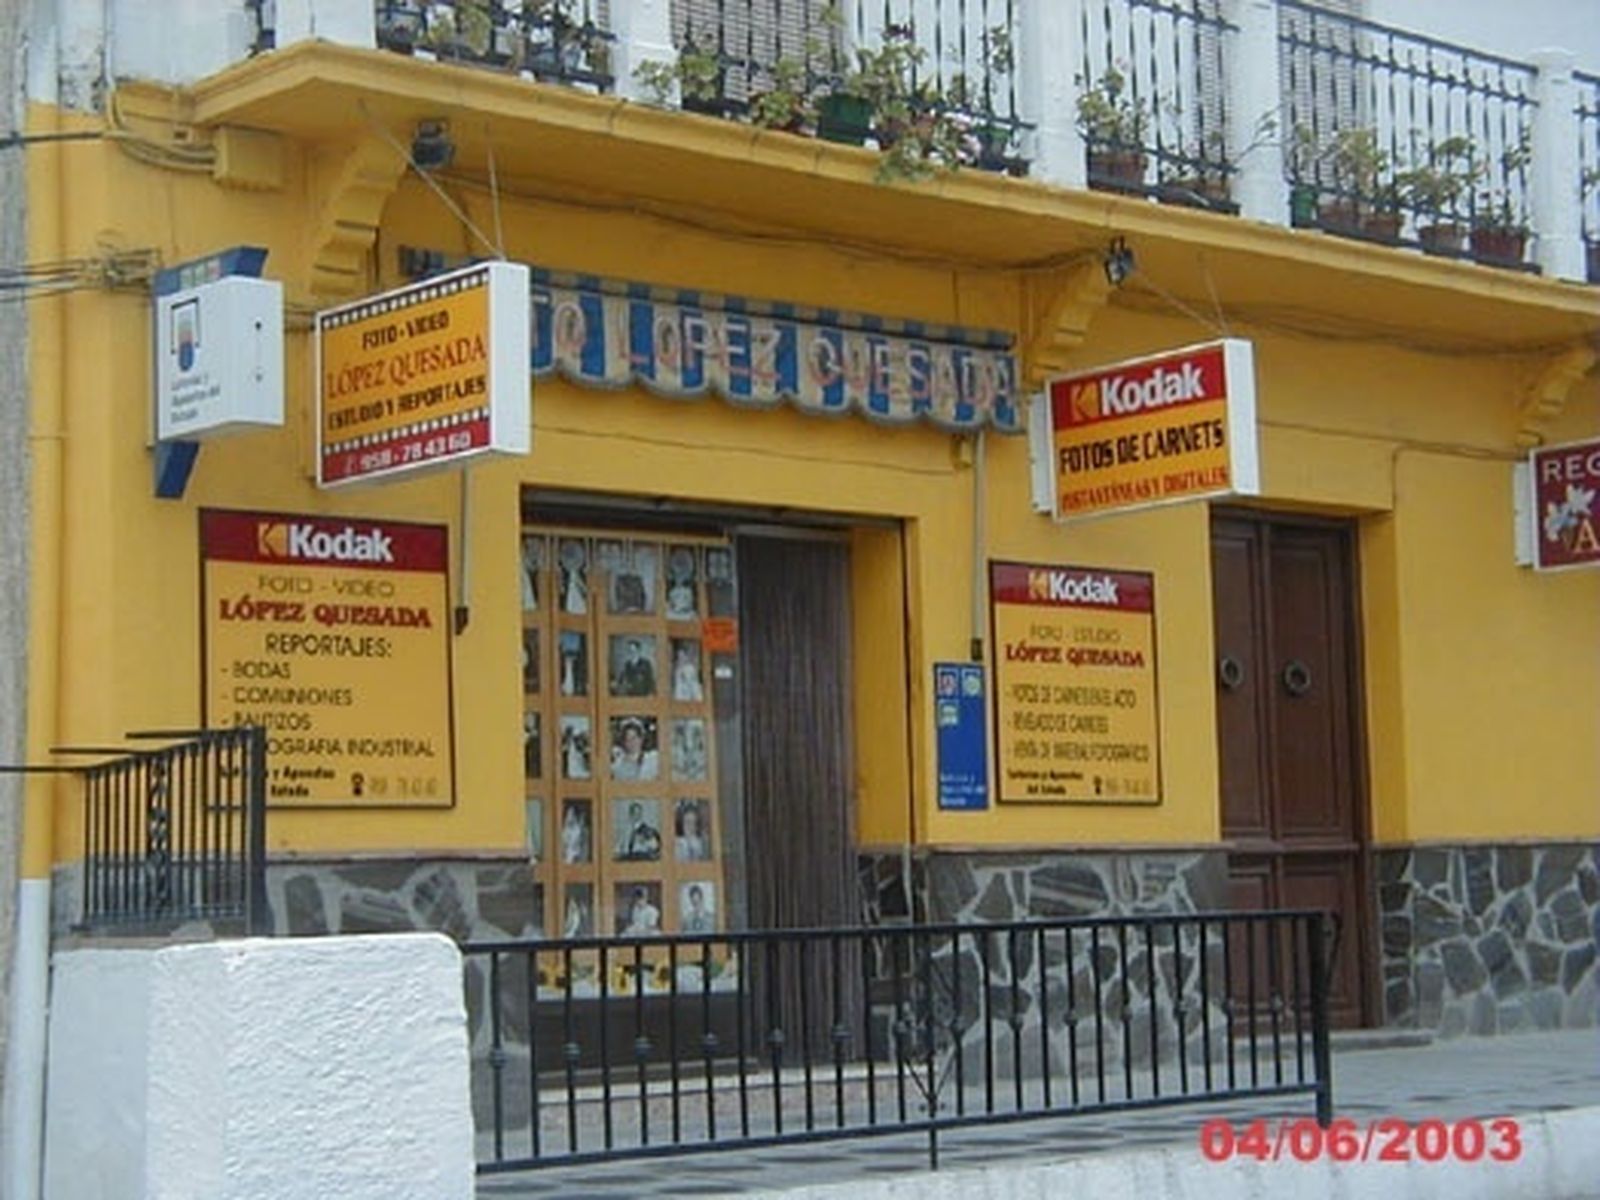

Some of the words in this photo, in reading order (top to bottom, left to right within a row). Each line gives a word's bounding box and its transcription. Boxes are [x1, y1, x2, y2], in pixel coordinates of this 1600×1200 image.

[362, 325, 397, 350] FOTO
[406, 310, 449, 338] VIDEO
[389, 333, 487, 386] QUESADA
[808, 335, 1018, 410] QUESADA
[328, 401, 384, 430] ESTUDIO
[398, 376, 486, 414] REPORTAJES
[1101, 362, 1206, 416] Kodak
[1060, 441, 1114, 475] FOTOS
[1116, 435, 1139, 463] DE
[1143, 419, 1226, 461] CARNETS
[289, 523, 394, 562] Kodak
[258, 575, 313, 594] FOTO
[332, 577, 395, 598] VIDEO
[1050, 571, 1119, 604] Kodak
[219, 594, 306, 624] LÓPEZ
[313, 602, 432, 628] QUESADA
[265, 633, 392, 657] REPORTAJES:
[1005, 639, 1061, 663] LÓPEZ
[1066, 647, 1145, 667] QUESADA
[233, 660, 291, 679] BODAS
[233, 686, 353, 706] COMUNIONES
[266, 738, 342, 757] OGRAFIA
[347, 740, 435, 758] INDUSTRIAL
